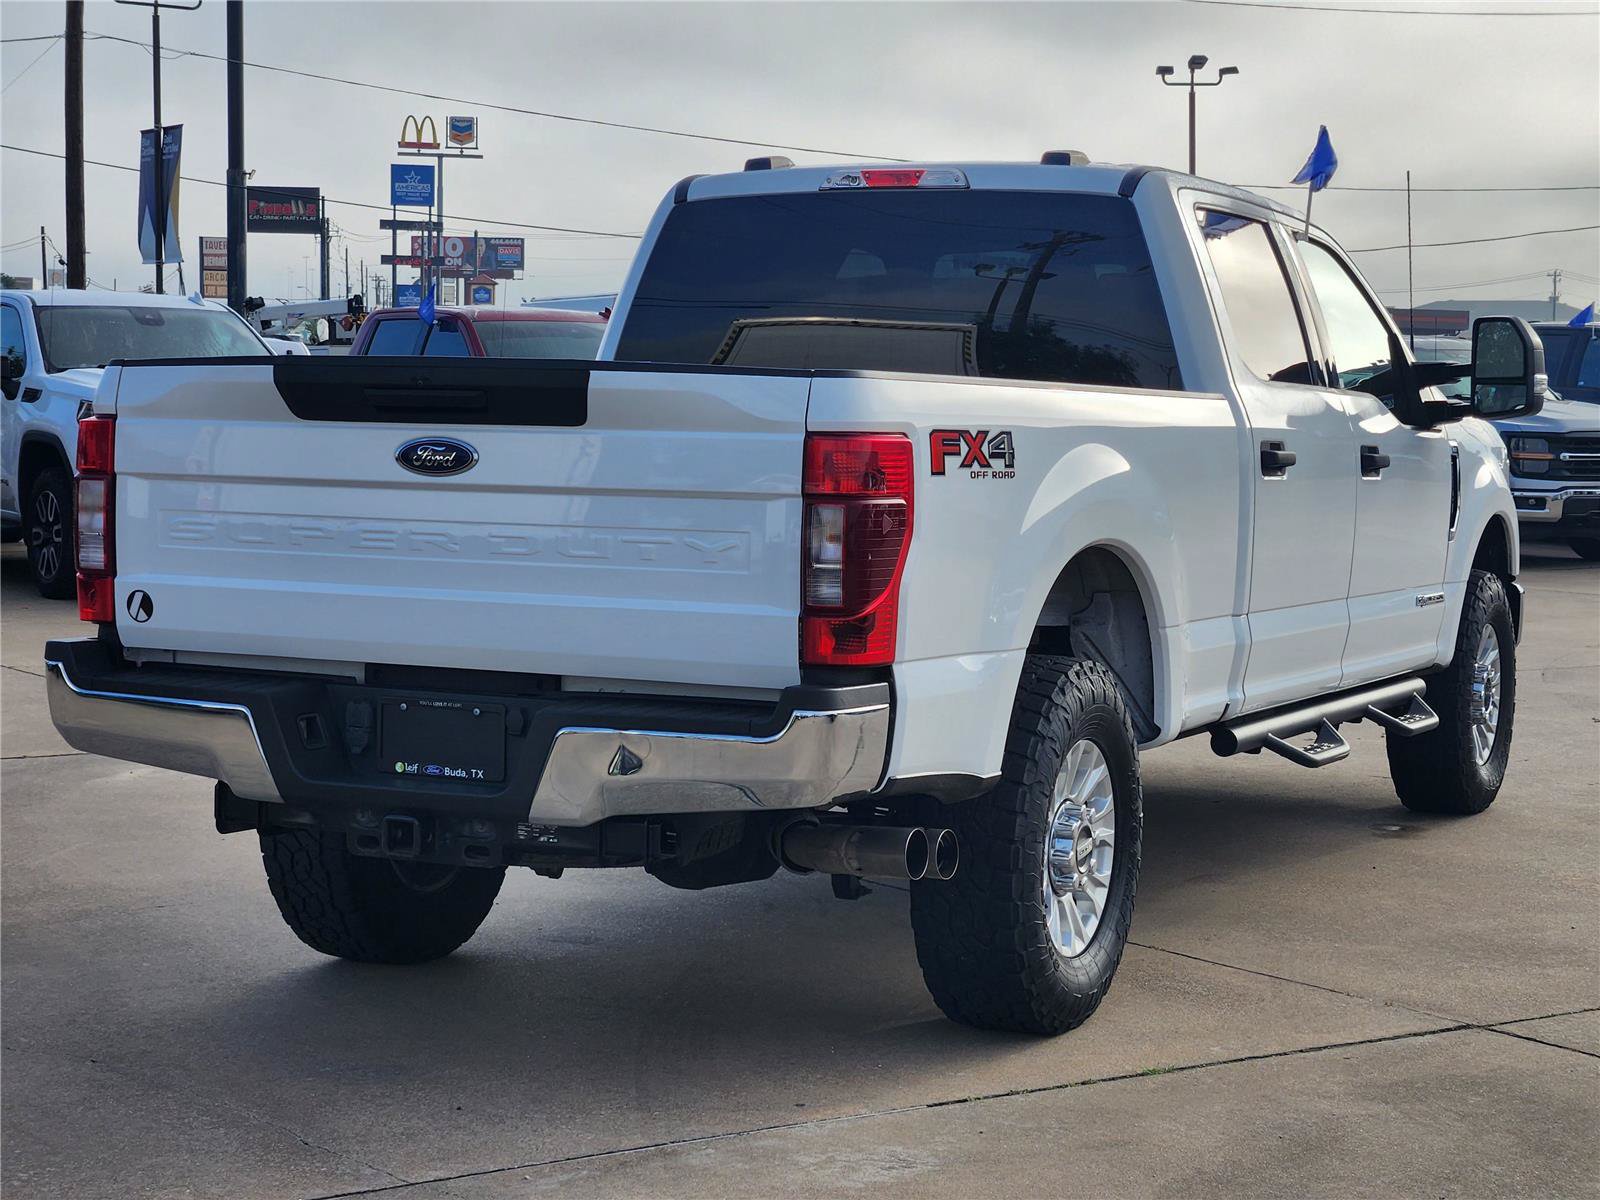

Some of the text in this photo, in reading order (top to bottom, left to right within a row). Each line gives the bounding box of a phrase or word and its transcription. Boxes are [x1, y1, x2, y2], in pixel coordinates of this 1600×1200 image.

[411, 445, 457, 467] Ford
[929, 429, 1016, 476] FX4
[970, 471, 1016, 479] OFF ROAD
[167, 515, 744, 565] SUPER DUTY
[444, 767, 484, 779] Buda, TX
